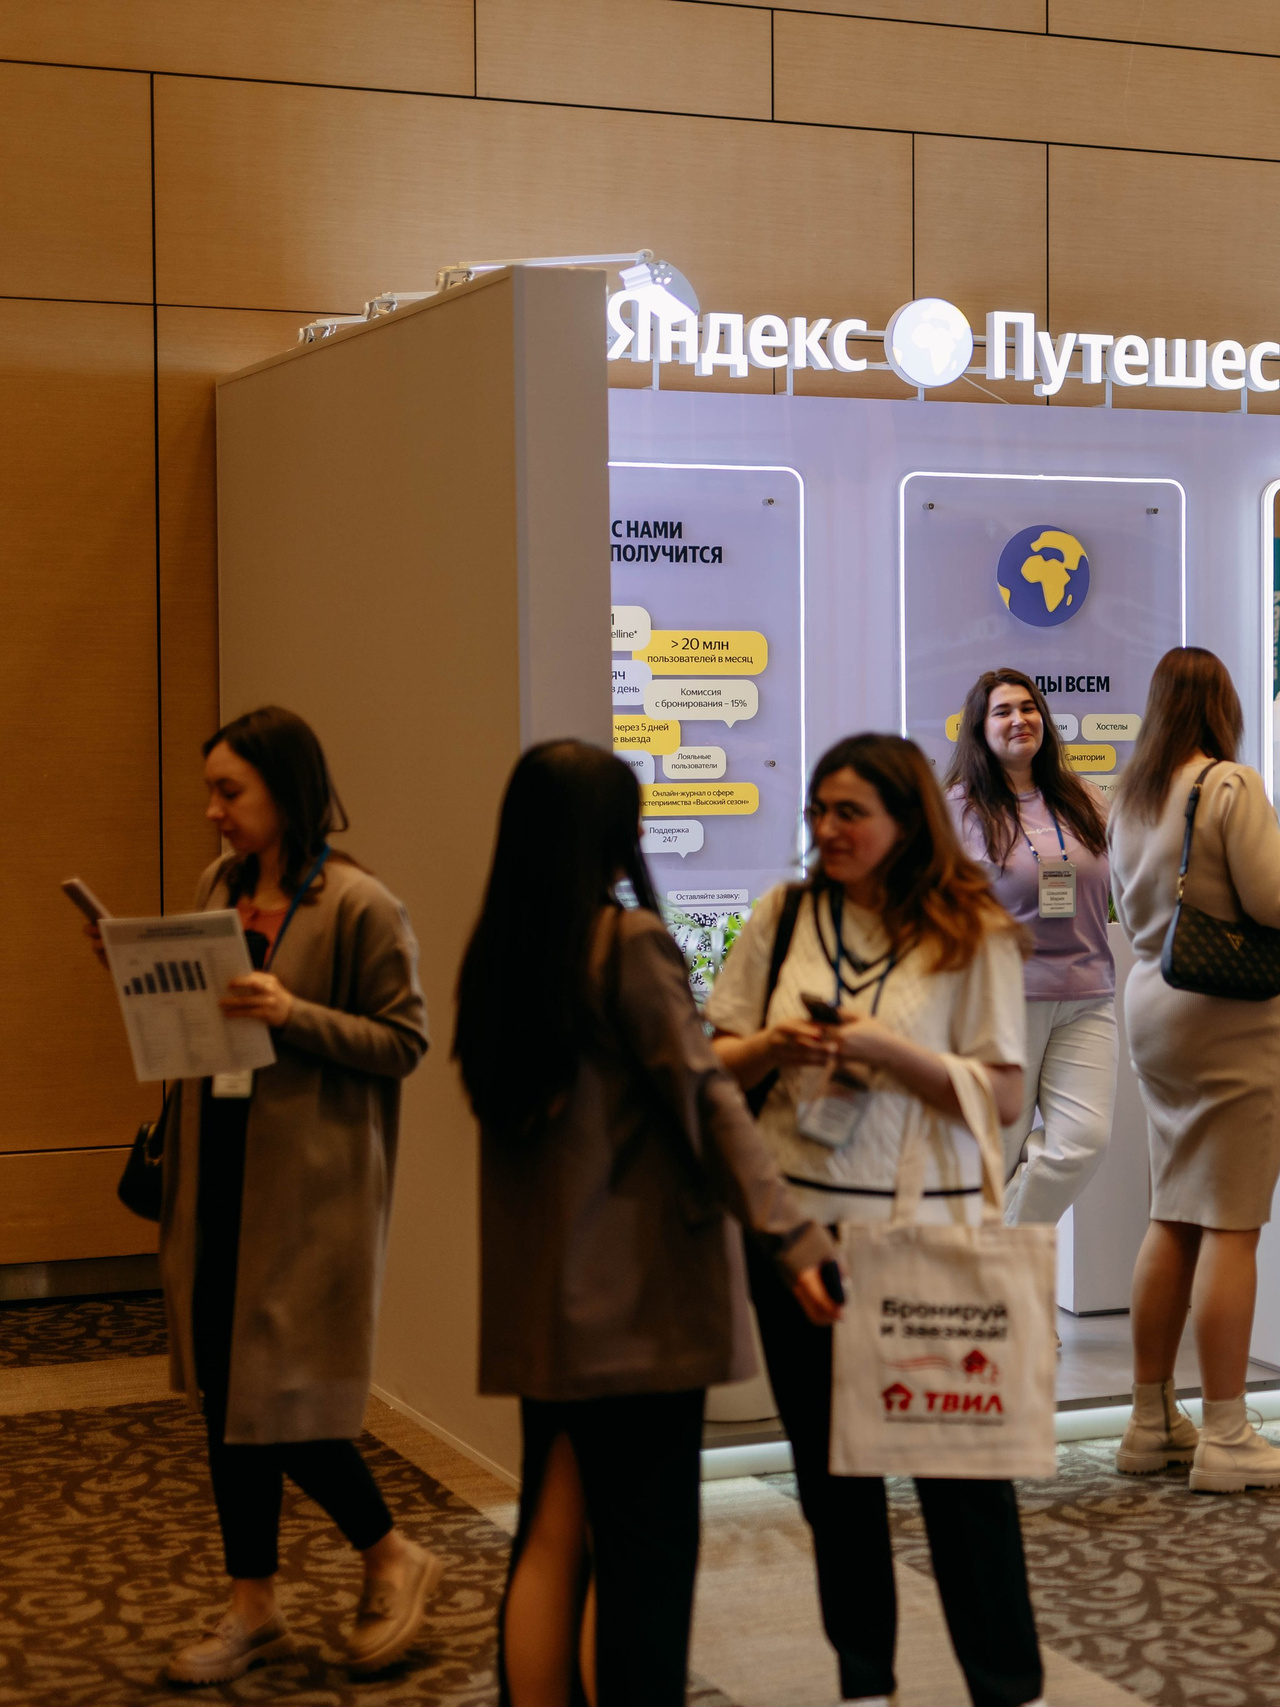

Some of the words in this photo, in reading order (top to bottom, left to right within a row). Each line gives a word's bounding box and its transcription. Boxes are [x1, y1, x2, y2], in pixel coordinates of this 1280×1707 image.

[606, 289, 868, 378] Яндекс
[612, 520, 623, 538] С
[627, 520, 683, 539] НАМИ
[611, 544, 723, 564] ПОЛУЧИТСЯ
[681, 638, 700, 650] 20
[702, 639, 730, 650] млн
[647, 654, 717, 663] пользователей
[725, 655, 754, 664] месяц
[617, 685, 641, 695] день
[1034, 675, 1062, 695] ДЫ
[1065, 676, 1110, 693] ВСЕМ
[680, 687, 722, 697] Комиссия
[661, 699, 723, 709] бронирования
[731, 699, 748, 708] 15%
[614, 724, 640, 733] через
[641, 723, 647, 731] 5
[648, 723, 670, 732] дней
[1096, 722, 1128, 731] Хостелы
[620, 736, 651, 744] выезда
[677, 753, 712, 761] Лояльные
[1064, 753, 1106, 763] Санатории
[671, 762, 718, 770] пользователи
[652, 789, 706, 798] Онлайн-журнал
[713, 789, 734, 798] сфере
[692, 798, 726, 807] «Высокий
[649, 826, 690, 835] Поддержка
[662, 835, 678, 843] 24/7
[675, 893, 716, 901] Оставляйте
[717, 893, 741, 901] заявку:
[881, 1299, 1009, 1325] Бронируй
[924, 1391, 1005, 1414] ТВИЛ
